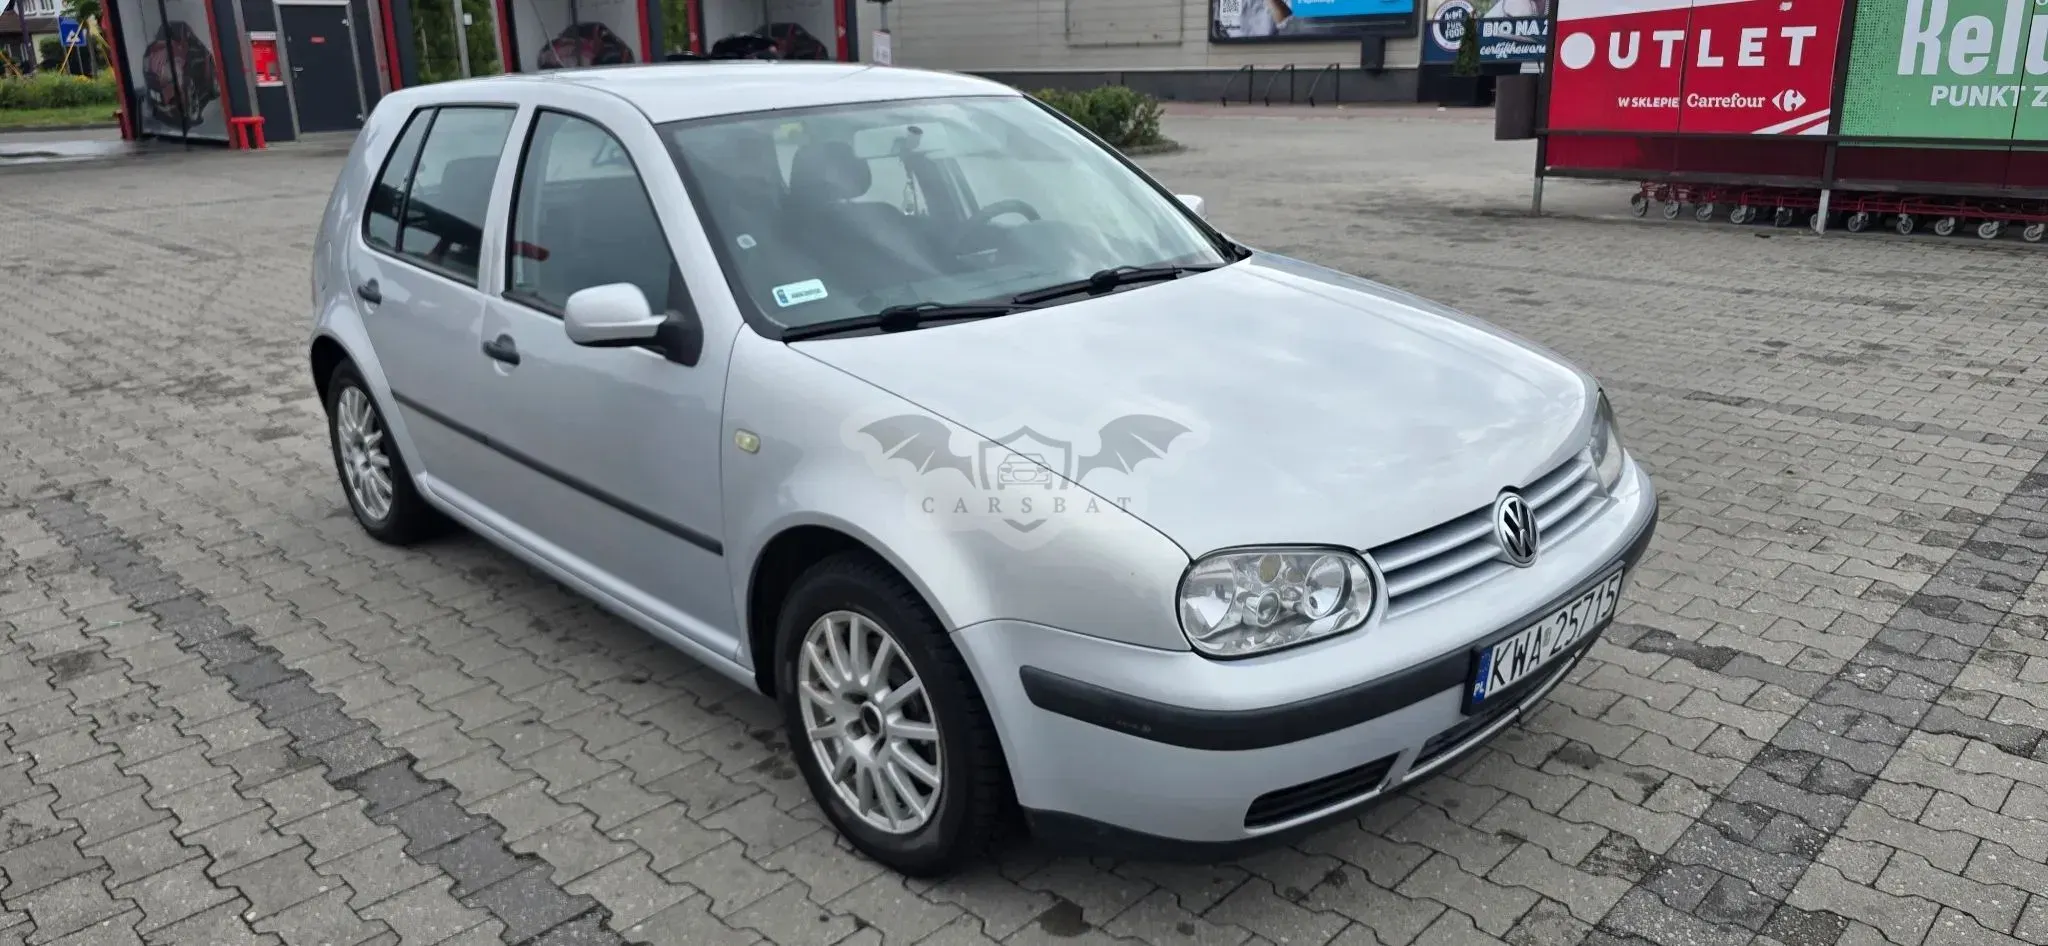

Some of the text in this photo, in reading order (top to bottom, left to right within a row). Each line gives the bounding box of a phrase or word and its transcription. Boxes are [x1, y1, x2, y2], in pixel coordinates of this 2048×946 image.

[1483, 21, 1513, 37] BIO
[1515, 20, 1540, 36] NA
[1560, 26, 1817, 69] OUTLET
[1618, 93, 1766, 108] W SKLEPIE Carrefour
[1930, 85, 2026, 107] PUNKT
[1489, 626, 1543, 692] KWA
[1549, 574, 1620, 657] 25715
